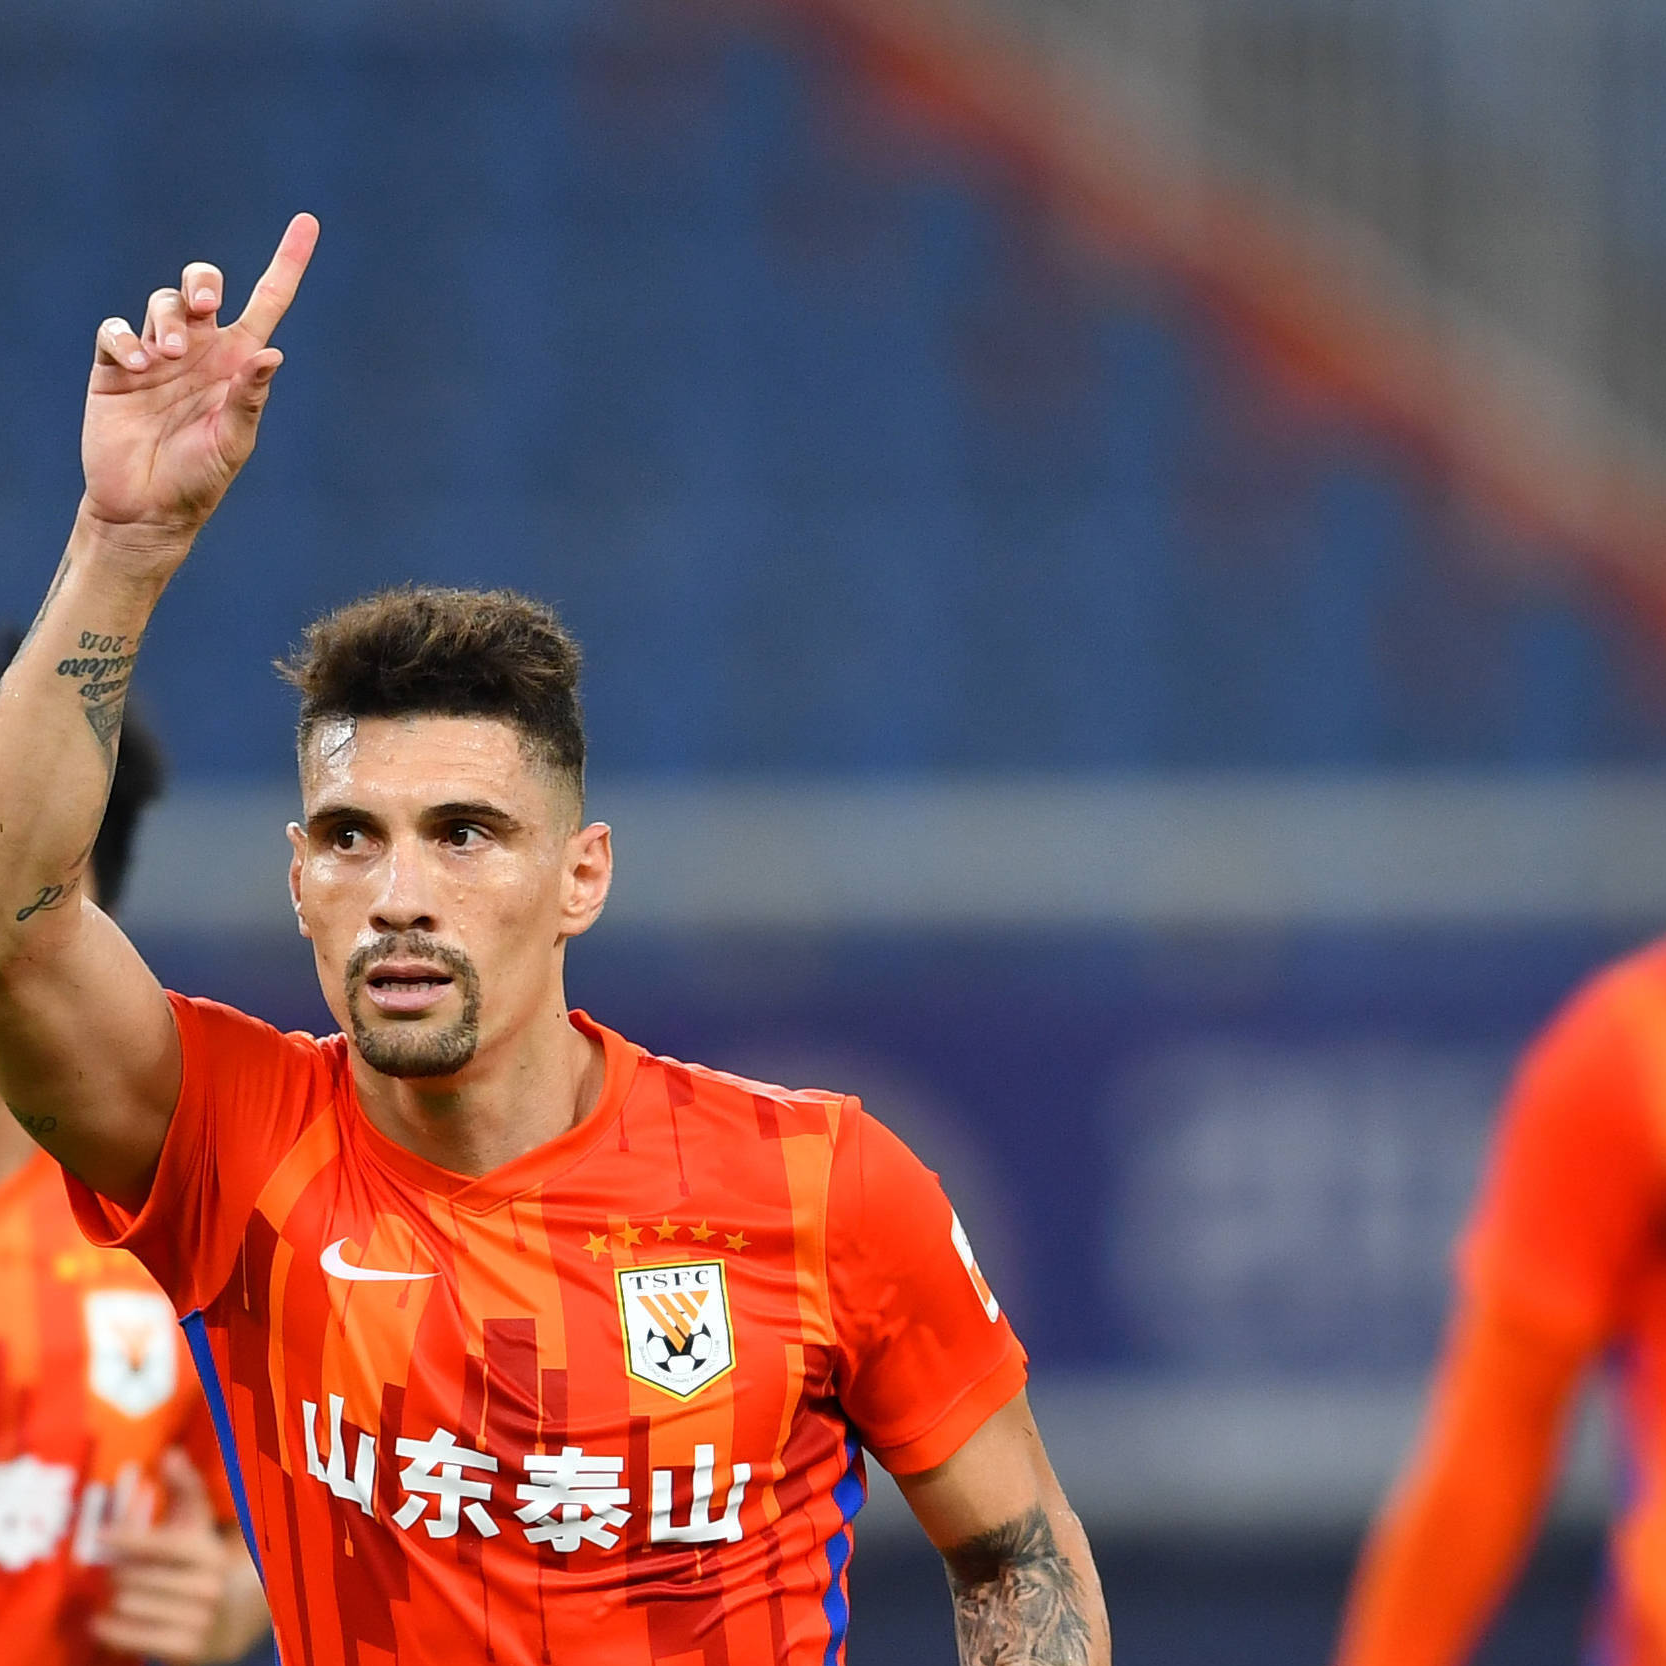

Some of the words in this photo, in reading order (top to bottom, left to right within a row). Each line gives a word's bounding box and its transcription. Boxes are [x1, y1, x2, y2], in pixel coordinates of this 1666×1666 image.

[629, 1270, 709, 1290] TSFC
[301, 1392, 753, 1553] 山东泰山
